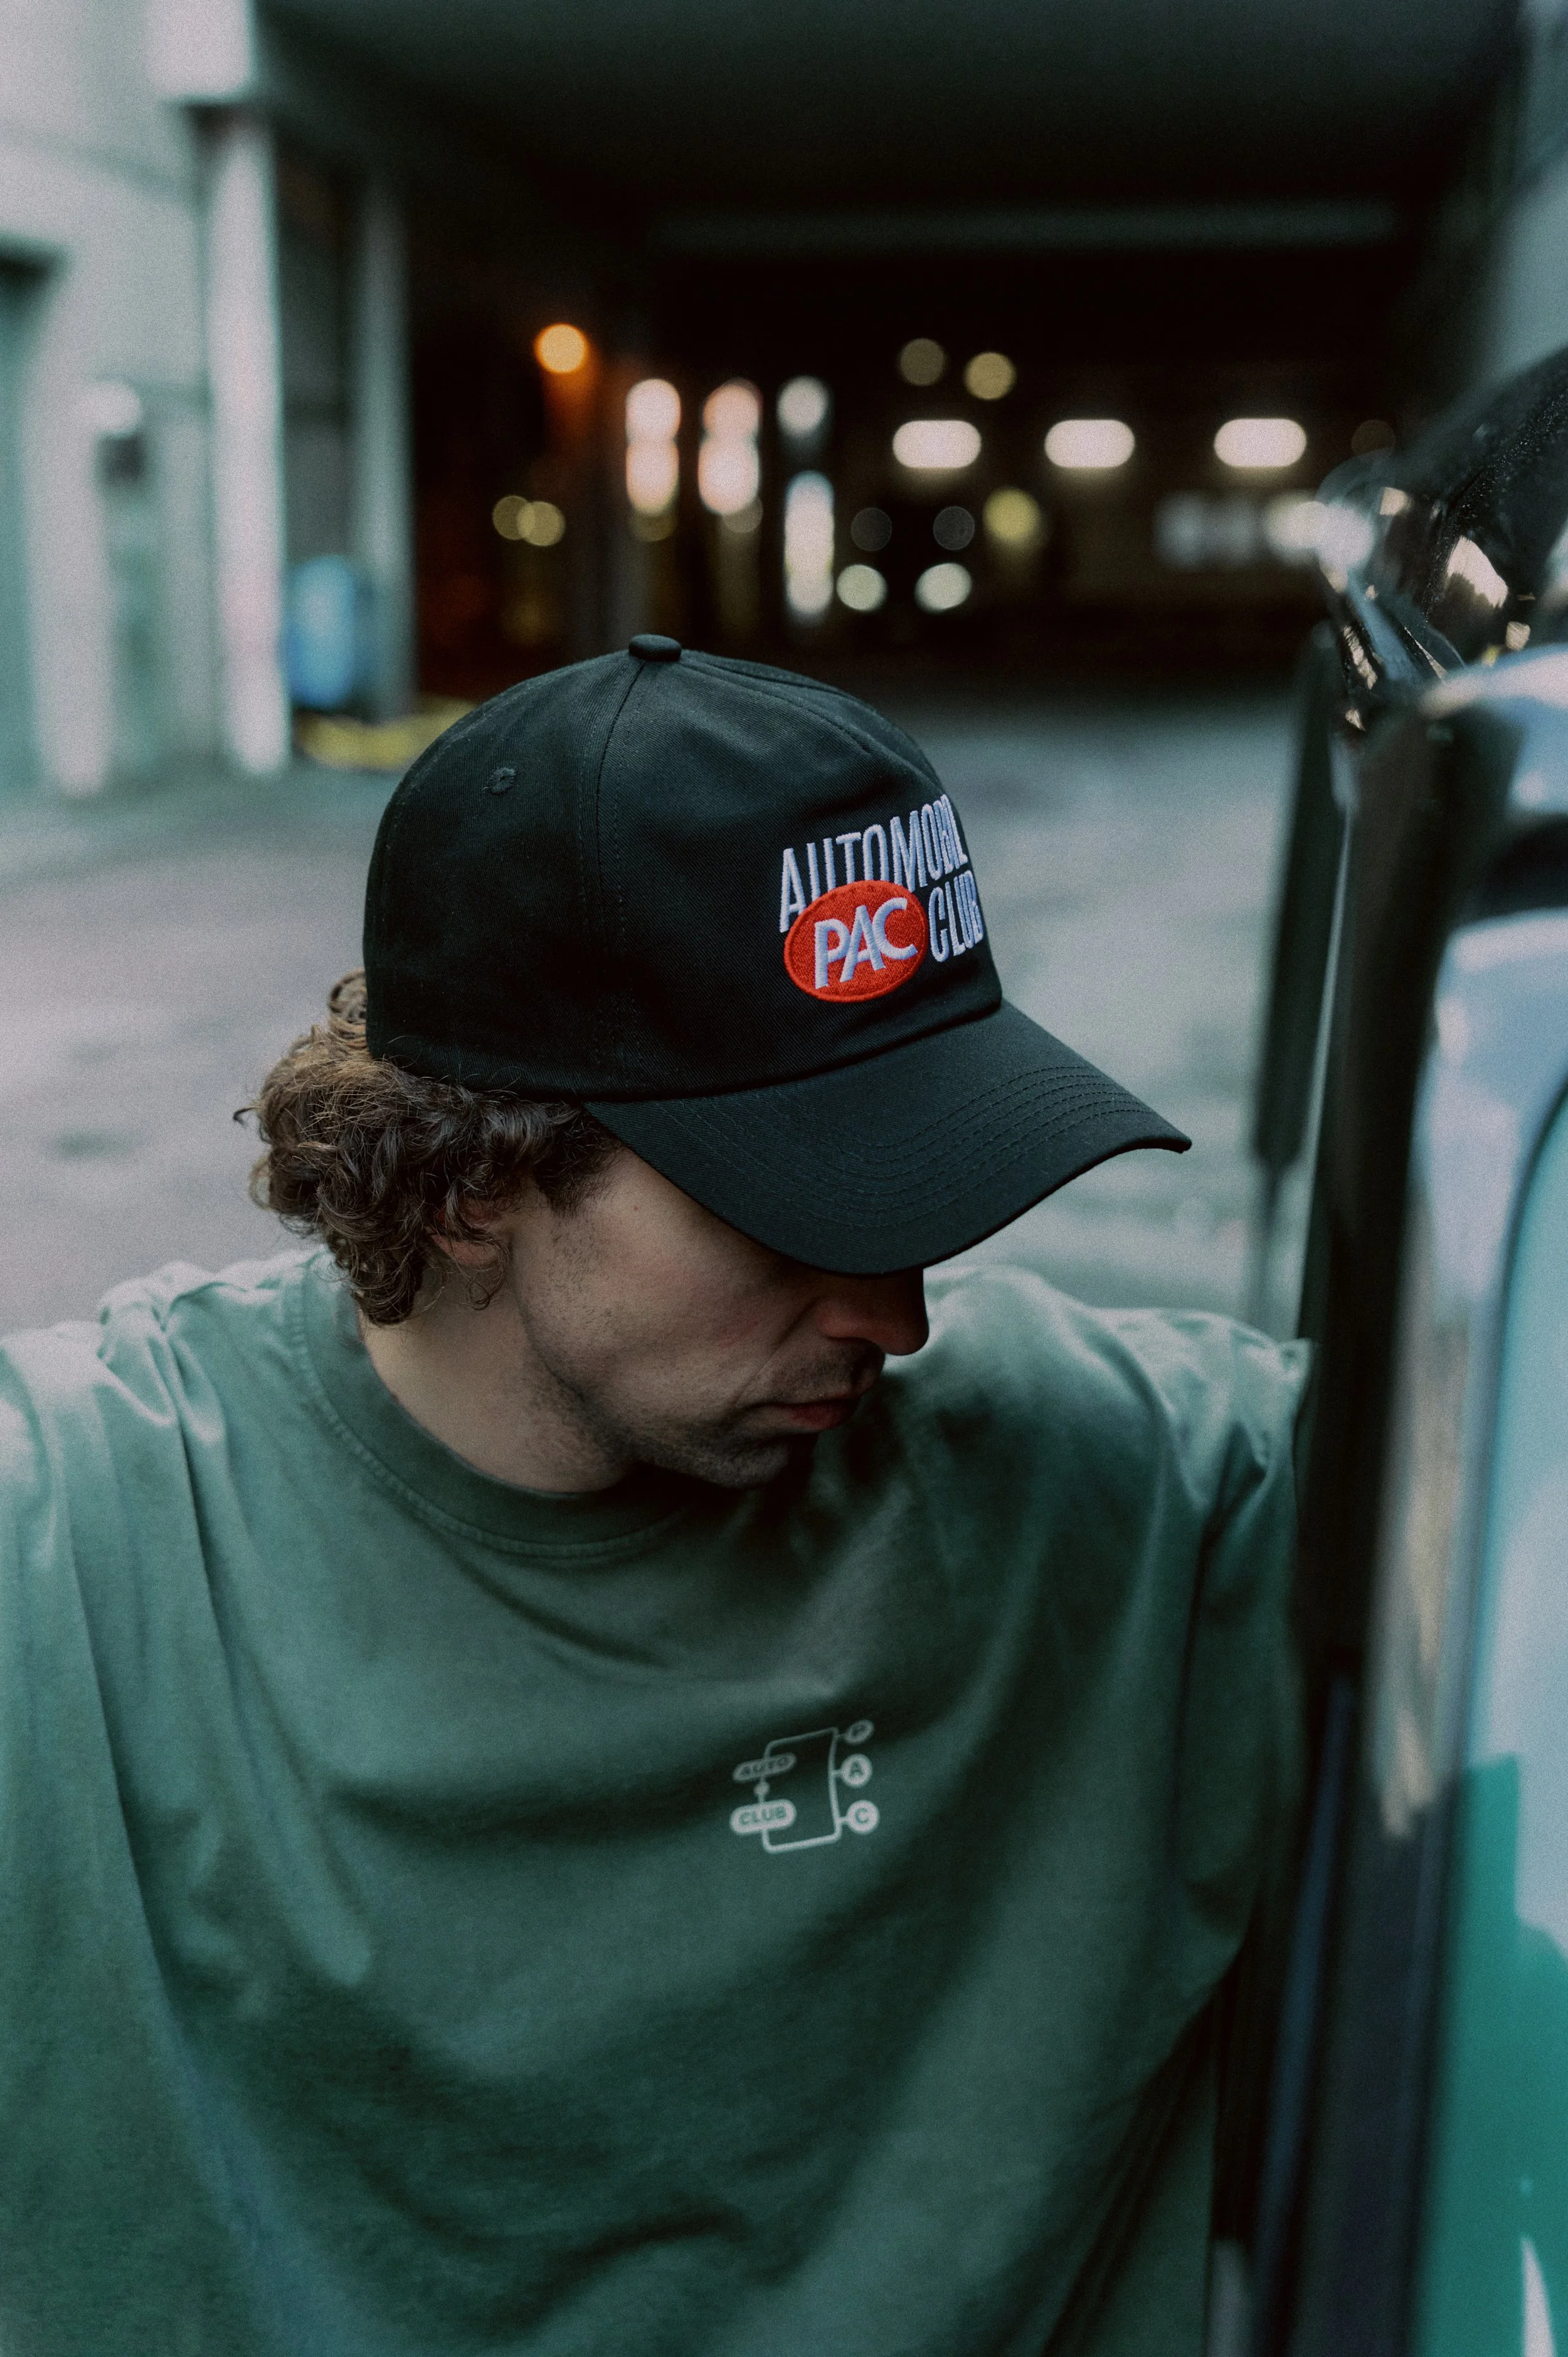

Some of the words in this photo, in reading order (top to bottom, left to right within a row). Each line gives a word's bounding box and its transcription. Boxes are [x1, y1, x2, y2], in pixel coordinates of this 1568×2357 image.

[928, 870, 983, 962] CLUB
[815, 897, 918, 989] PAC
[849, 1760, 864, 1778] A
[738, 1806, 787, 1826] CLUB
[854, 1807, 869, 1824] C
